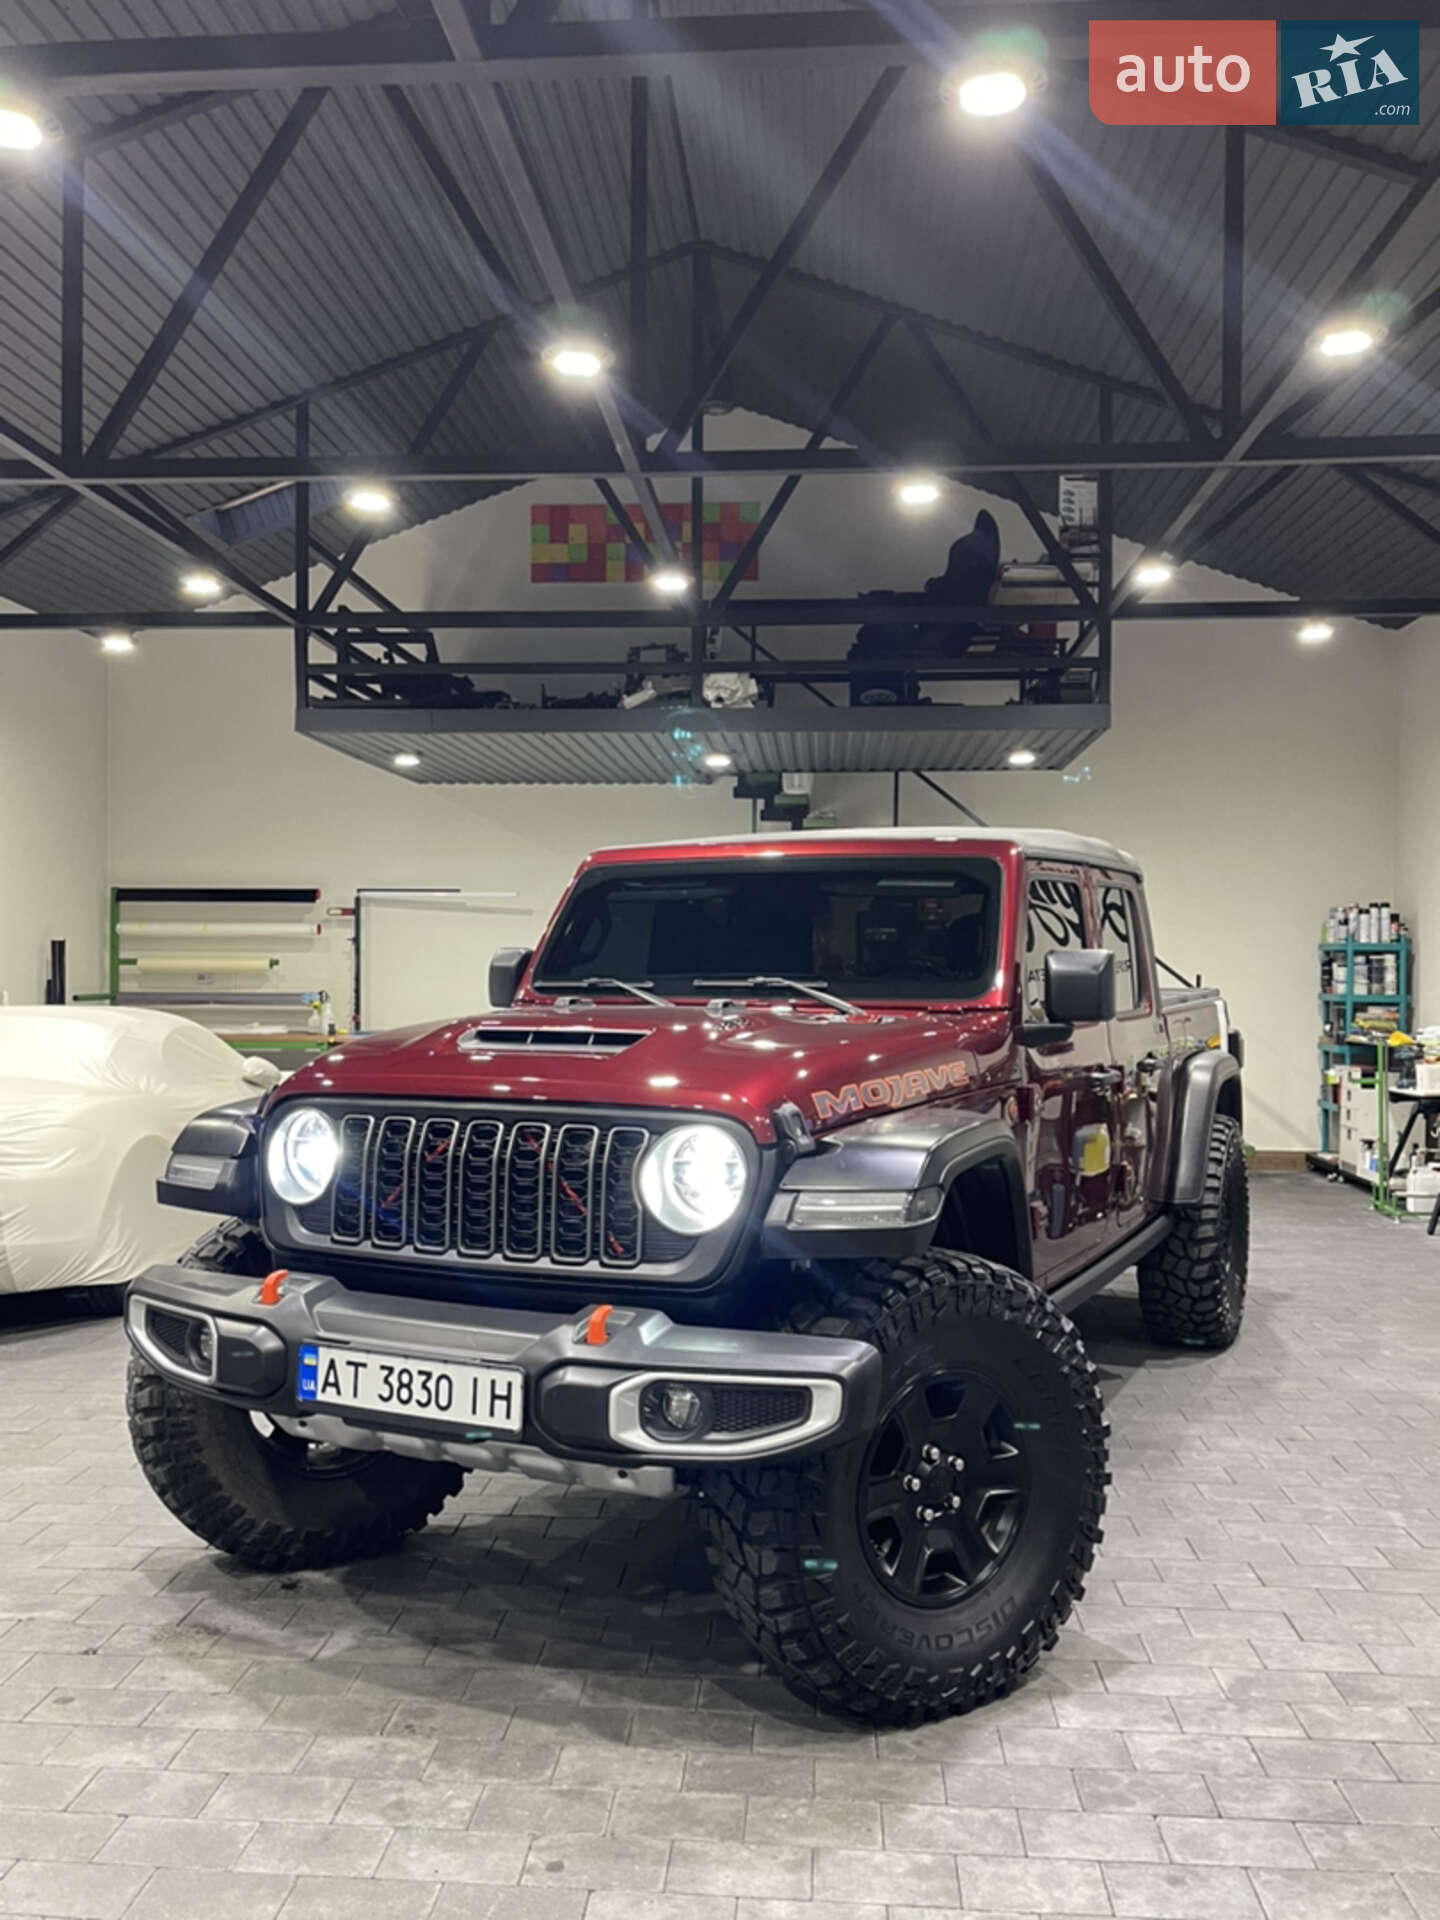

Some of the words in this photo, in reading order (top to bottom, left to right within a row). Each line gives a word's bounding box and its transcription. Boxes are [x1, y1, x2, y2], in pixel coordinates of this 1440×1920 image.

[811, 1060, 970, 1120] MOJAVE
[301, 1378, 316, 1391] UA
[321, 1358, 367, 1398] AT
[377, 1365, 453, 1411] 3830
[471, 1376, 513, 1420] IH
[855, 1584, 1018, 1652] DISCOVER
